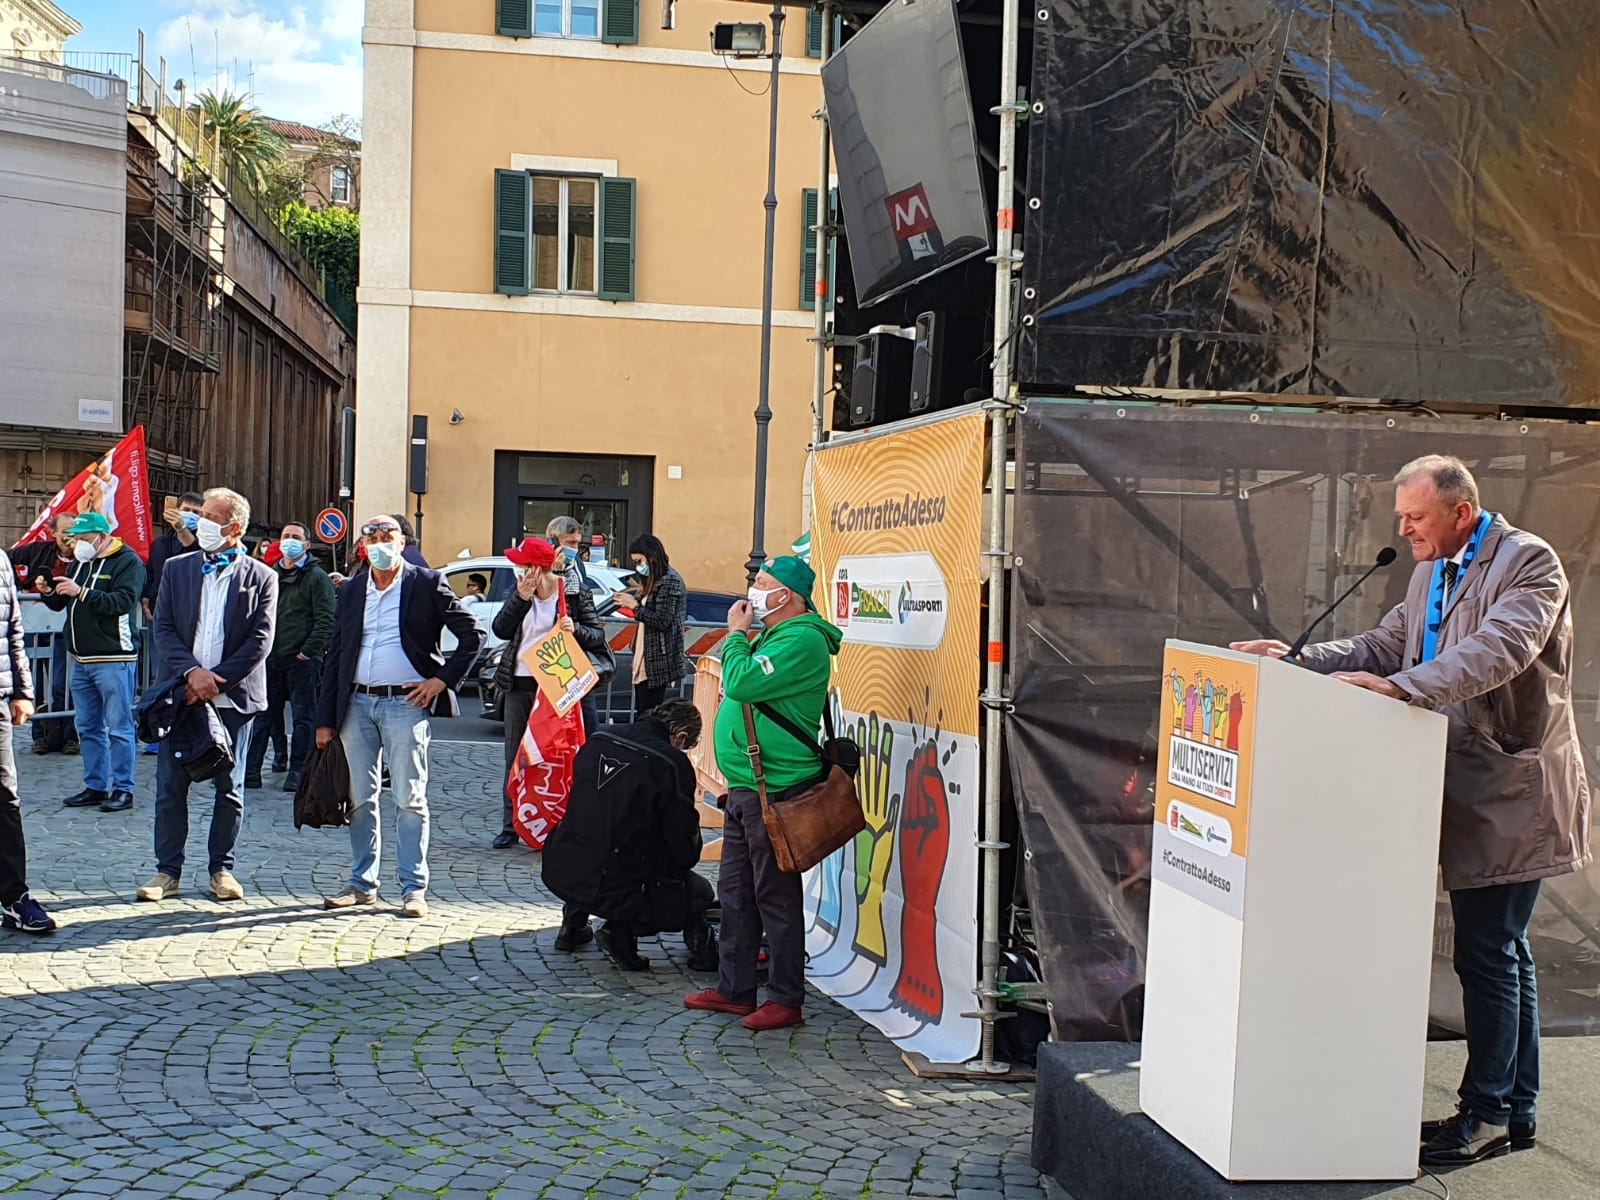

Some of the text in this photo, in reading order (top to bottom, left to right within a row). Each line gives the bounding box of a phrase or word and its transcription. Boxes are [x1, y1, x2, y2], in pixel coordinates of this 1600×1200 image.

[831, 491, 946, 533] #ContrattoAdesso
[1172, 740, 1234, 788] MULTISERVIZI
[1162, 849, 1231, 893] #ContrattoAdesso
